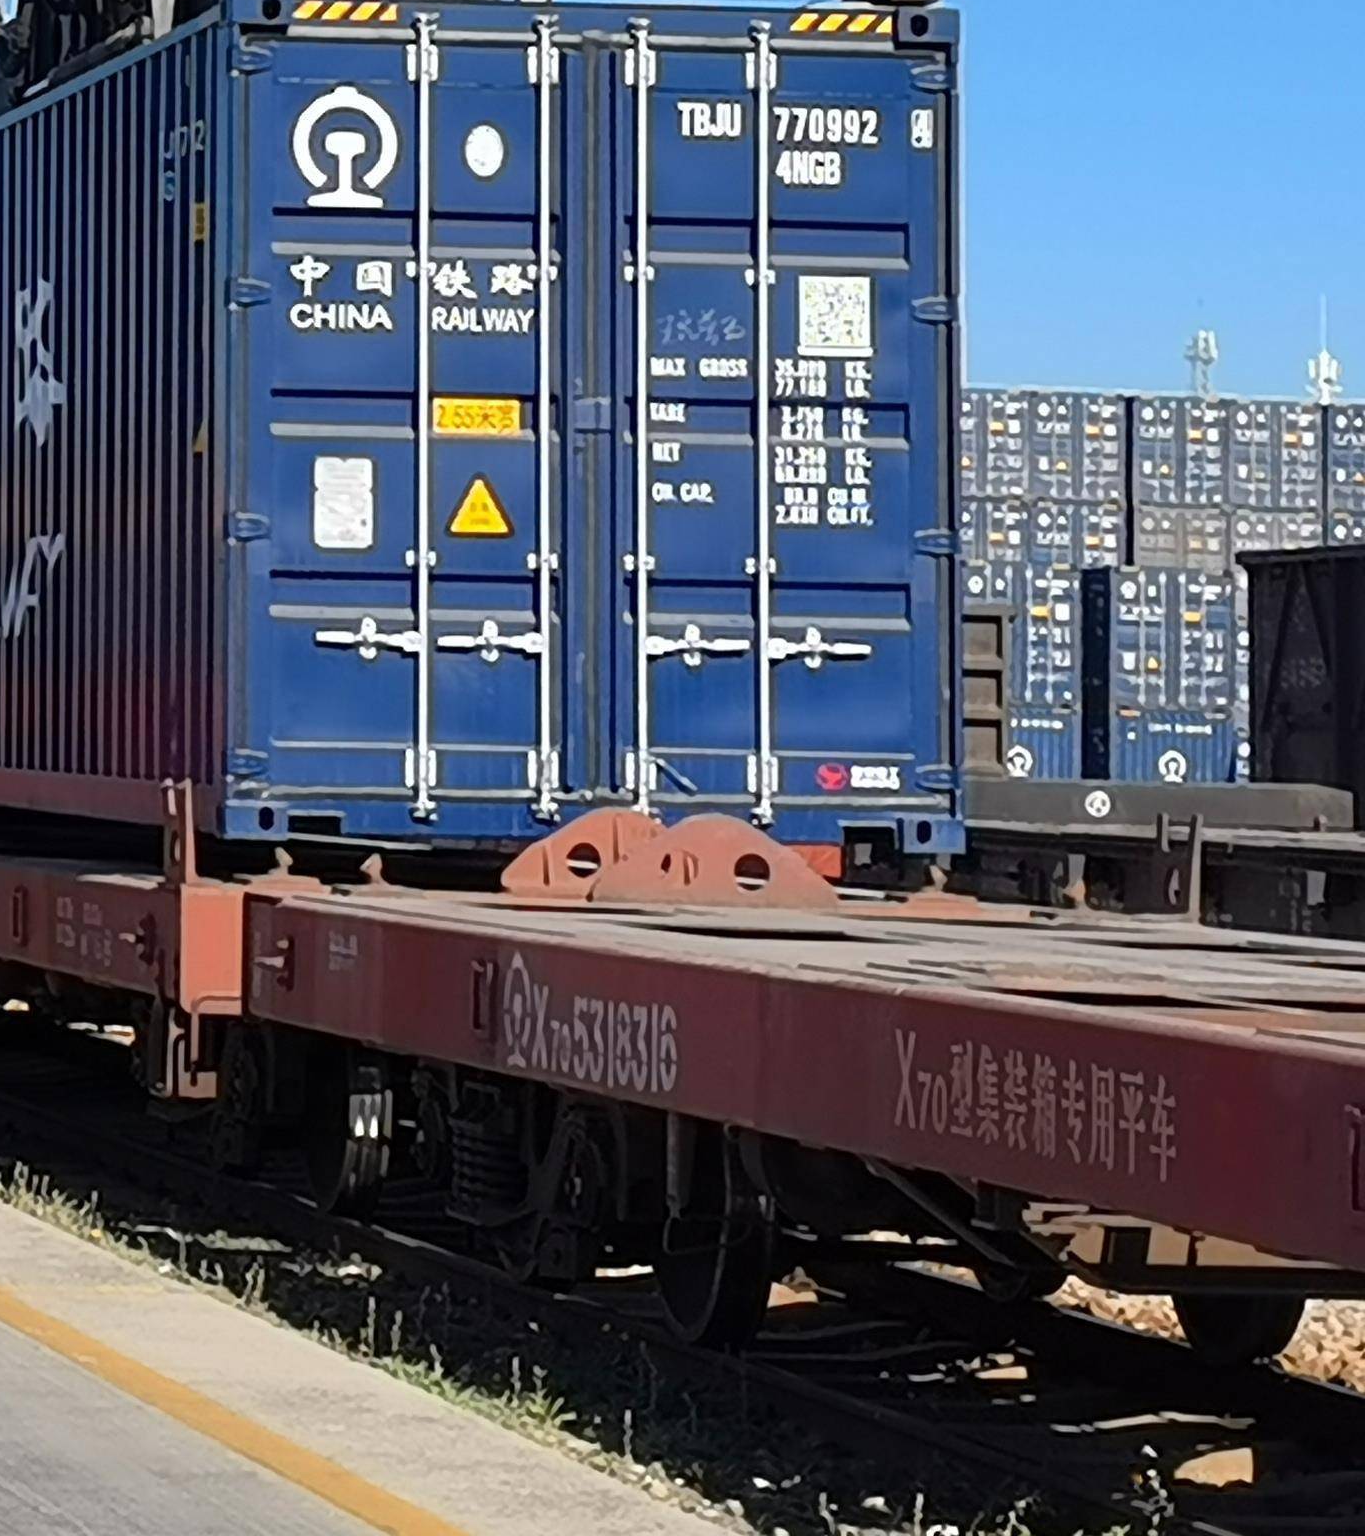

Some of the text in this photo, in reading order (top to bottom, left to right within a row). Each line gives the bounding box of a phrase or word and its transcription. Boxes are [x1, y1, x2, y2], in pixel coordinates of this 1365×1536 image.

[677, 102, 742, 136] TBJU
[773, 107, 879, 144] 770992
[775, 150, 842, 185] 4NGB
[289, 304, 535, 333] CHINA RAILWAY
